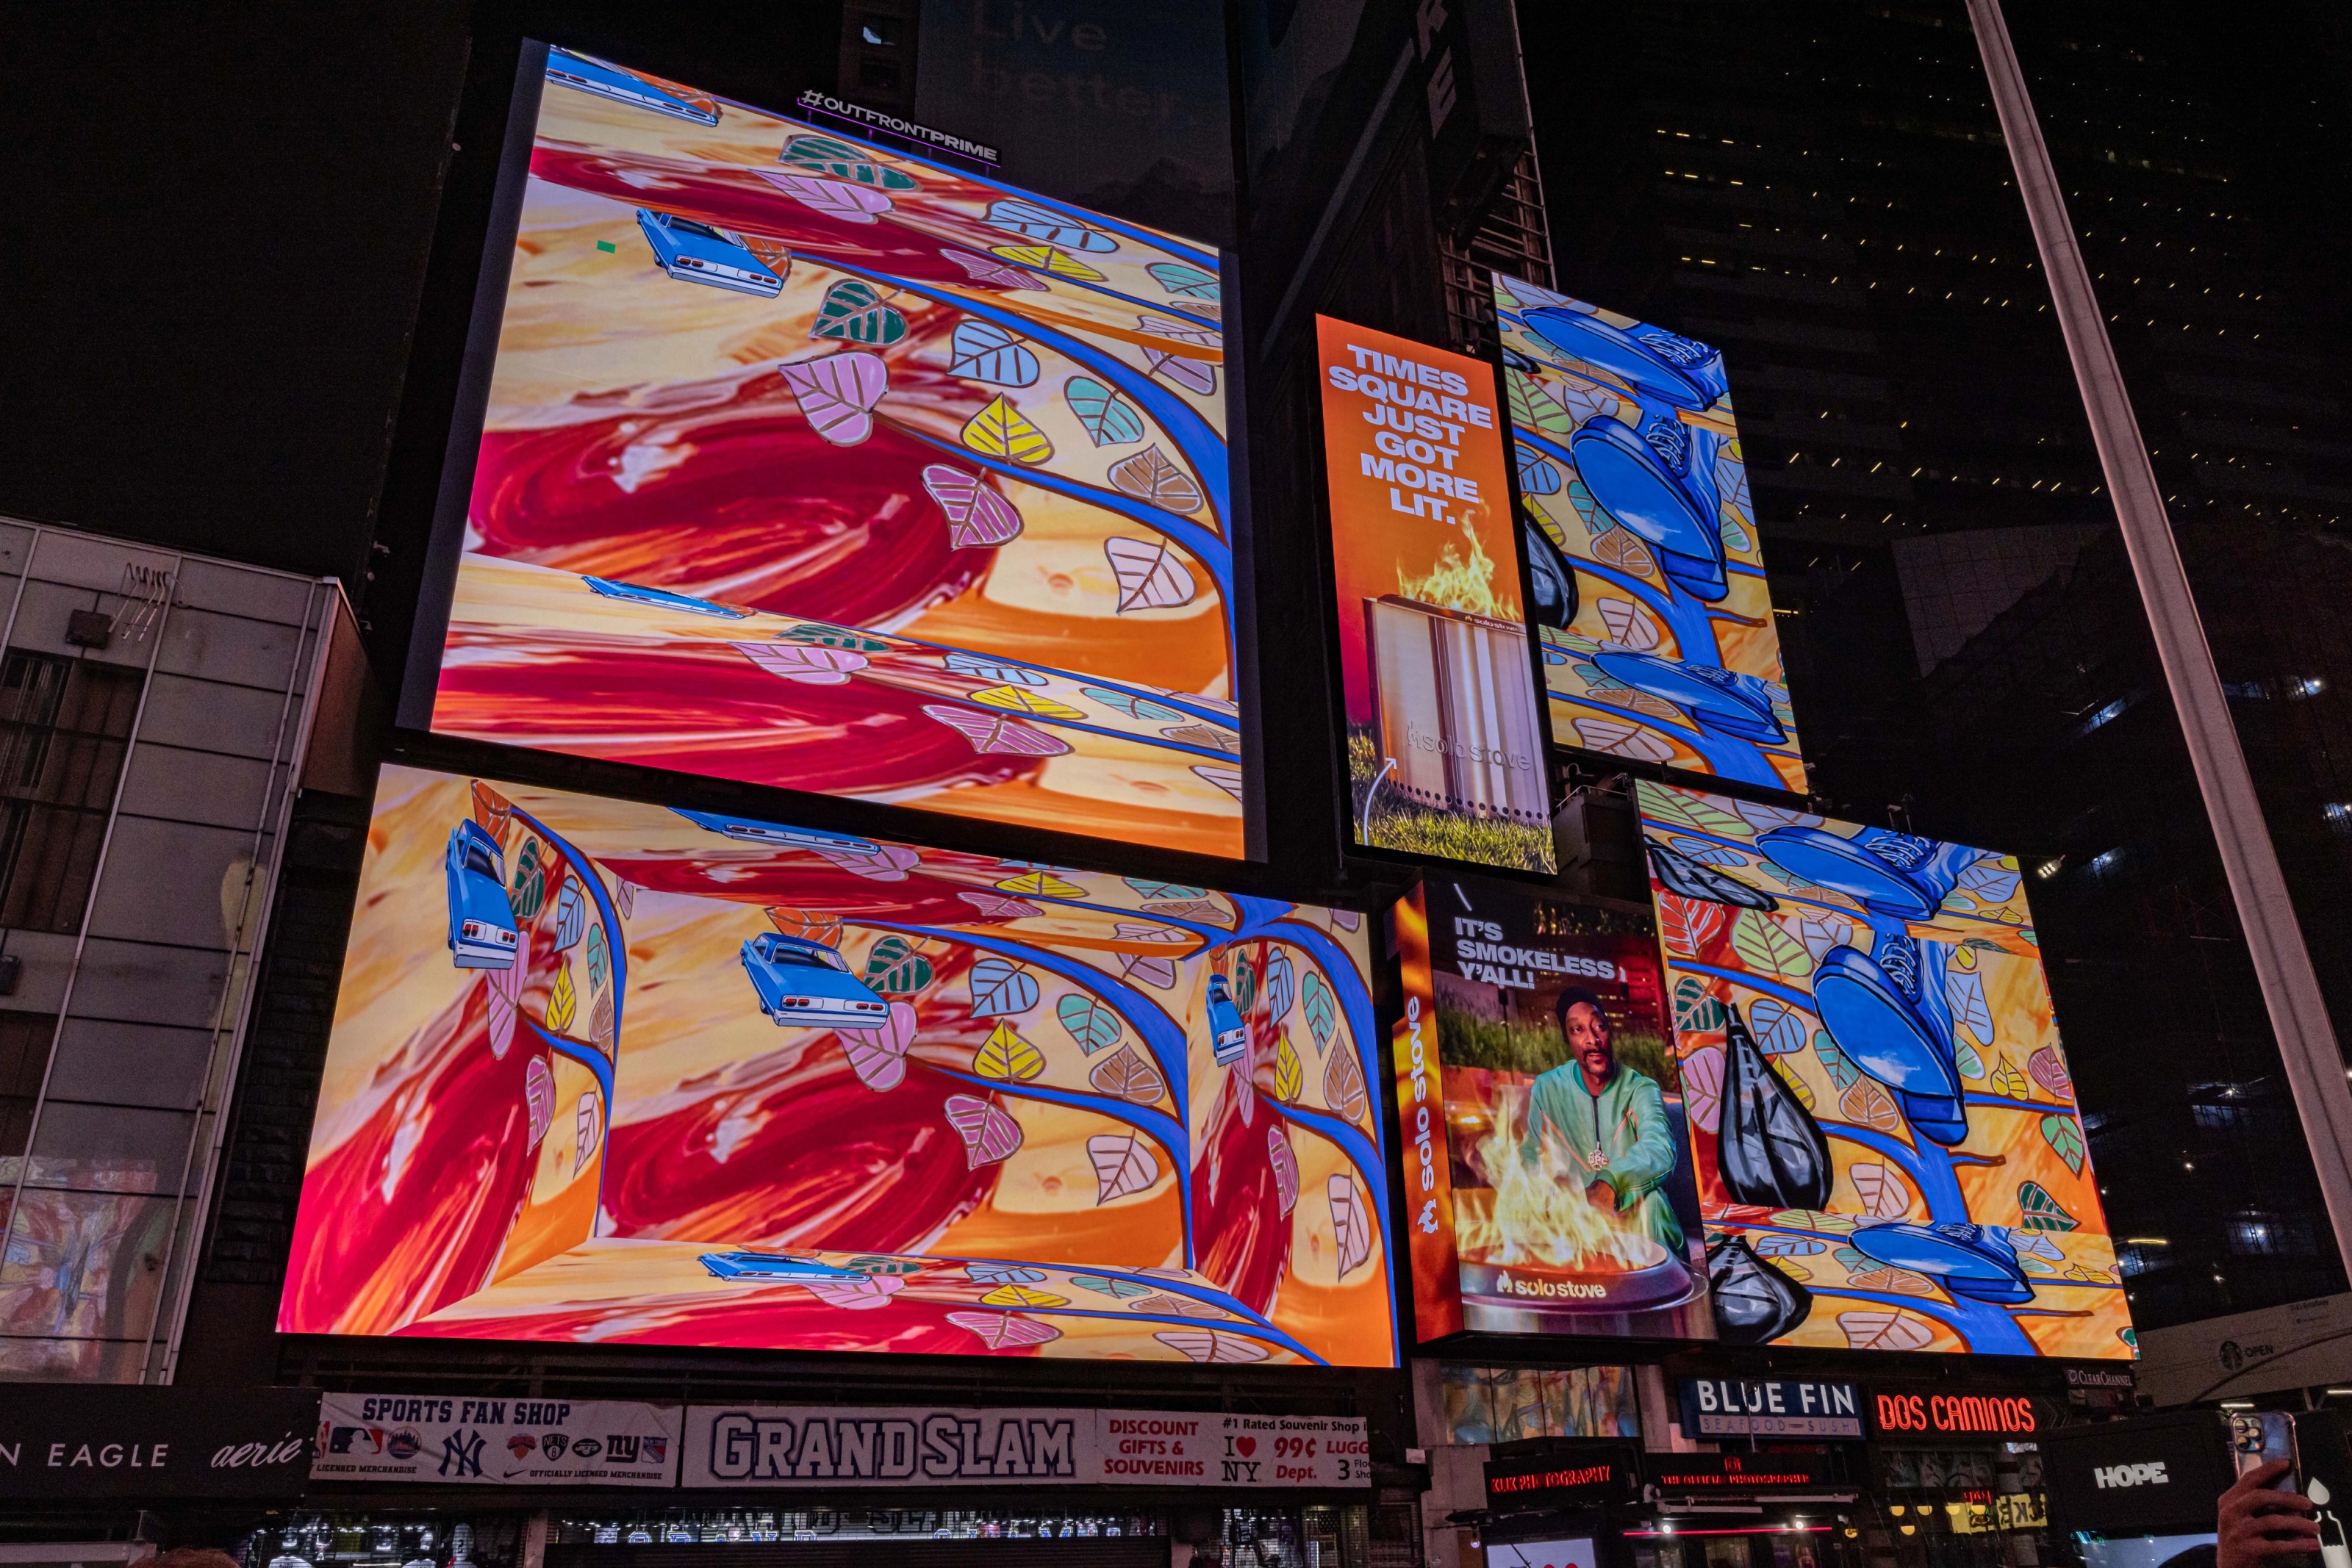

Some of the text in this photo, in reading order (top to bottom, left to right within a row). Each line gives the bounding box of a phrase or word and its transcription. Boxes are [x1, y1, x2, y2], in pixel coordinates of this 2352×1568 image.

[801, 89, 997, 162] #OUTFRONTPRIME
[1347, 343, 1468, 396] TIMES
[1329, 366, 1492, 429] SQUARE
[1363, 403, 1465, 446] JUST
[1374, 431, 1459, 470] GOT
[1360, 453, 1480, 503] MORE
[1390, 487, 1456, 525] LIT.
[1474, 618, 1494, 627] solo
[1423, 735, 1530, 770] solo stove
[1455, 917, 1504, 941] IT'S
[1457, 940, 1616, 979] SMOKELESS
[1457, 960, 1535, 990] Y'ALL!
[1408, 996, 1435, 1192] solo stove
[1515, 1279, 1607, 1298] solo stove
[2245, 1344, 2273, 1357] OPEN
[1697, 1381, 1855, 1414] BLUE FIN
[362, 1398, 570, 1425] SPORTS FAN SHOP
[1877, 1394, 2035, 1432] DOS CAMINOS
[1108, 1419, 1199, 1436] DISCOUNT
[1222, 1417, 1238, 1429] #1
[1244, 1418, 1275, 1430] Rated
[1280, 1419, 1328, 1431] Souvenir
[1331, 1420, 1360, 1434] Shop
[1704, 1418, 1858, 1434] SEAFOOD SUSHI
[211, 1431, 302, 1468] aerie
[542, 1435, 567, 1447] NETS
[1119, 1439, 1184, 1456] GIFTS &
[1224, 1436, 1235, 1456] I
[1274, 1436, 1316, 1459] 99¢
[48, 1444, 168, 1467] EAGLE
[1104, 1459, 1204, 1476] SOUVENIRS
[316, 1464, 356, 1472] LICENSED
[359, 1464, 417, 1474] MERCHANDISE
[530, 1470, 573, 1478] OFFICIALLY
[610, 1471, 662, 1480] MERCHANDISE
[1222, 1461, 1261, 1483] NY
[1275, 1464, 1317, 1482] Dept.
[1338, 1459, 1350, 1481] 3
[2094, 1461, 2169, 1489] HOPE
